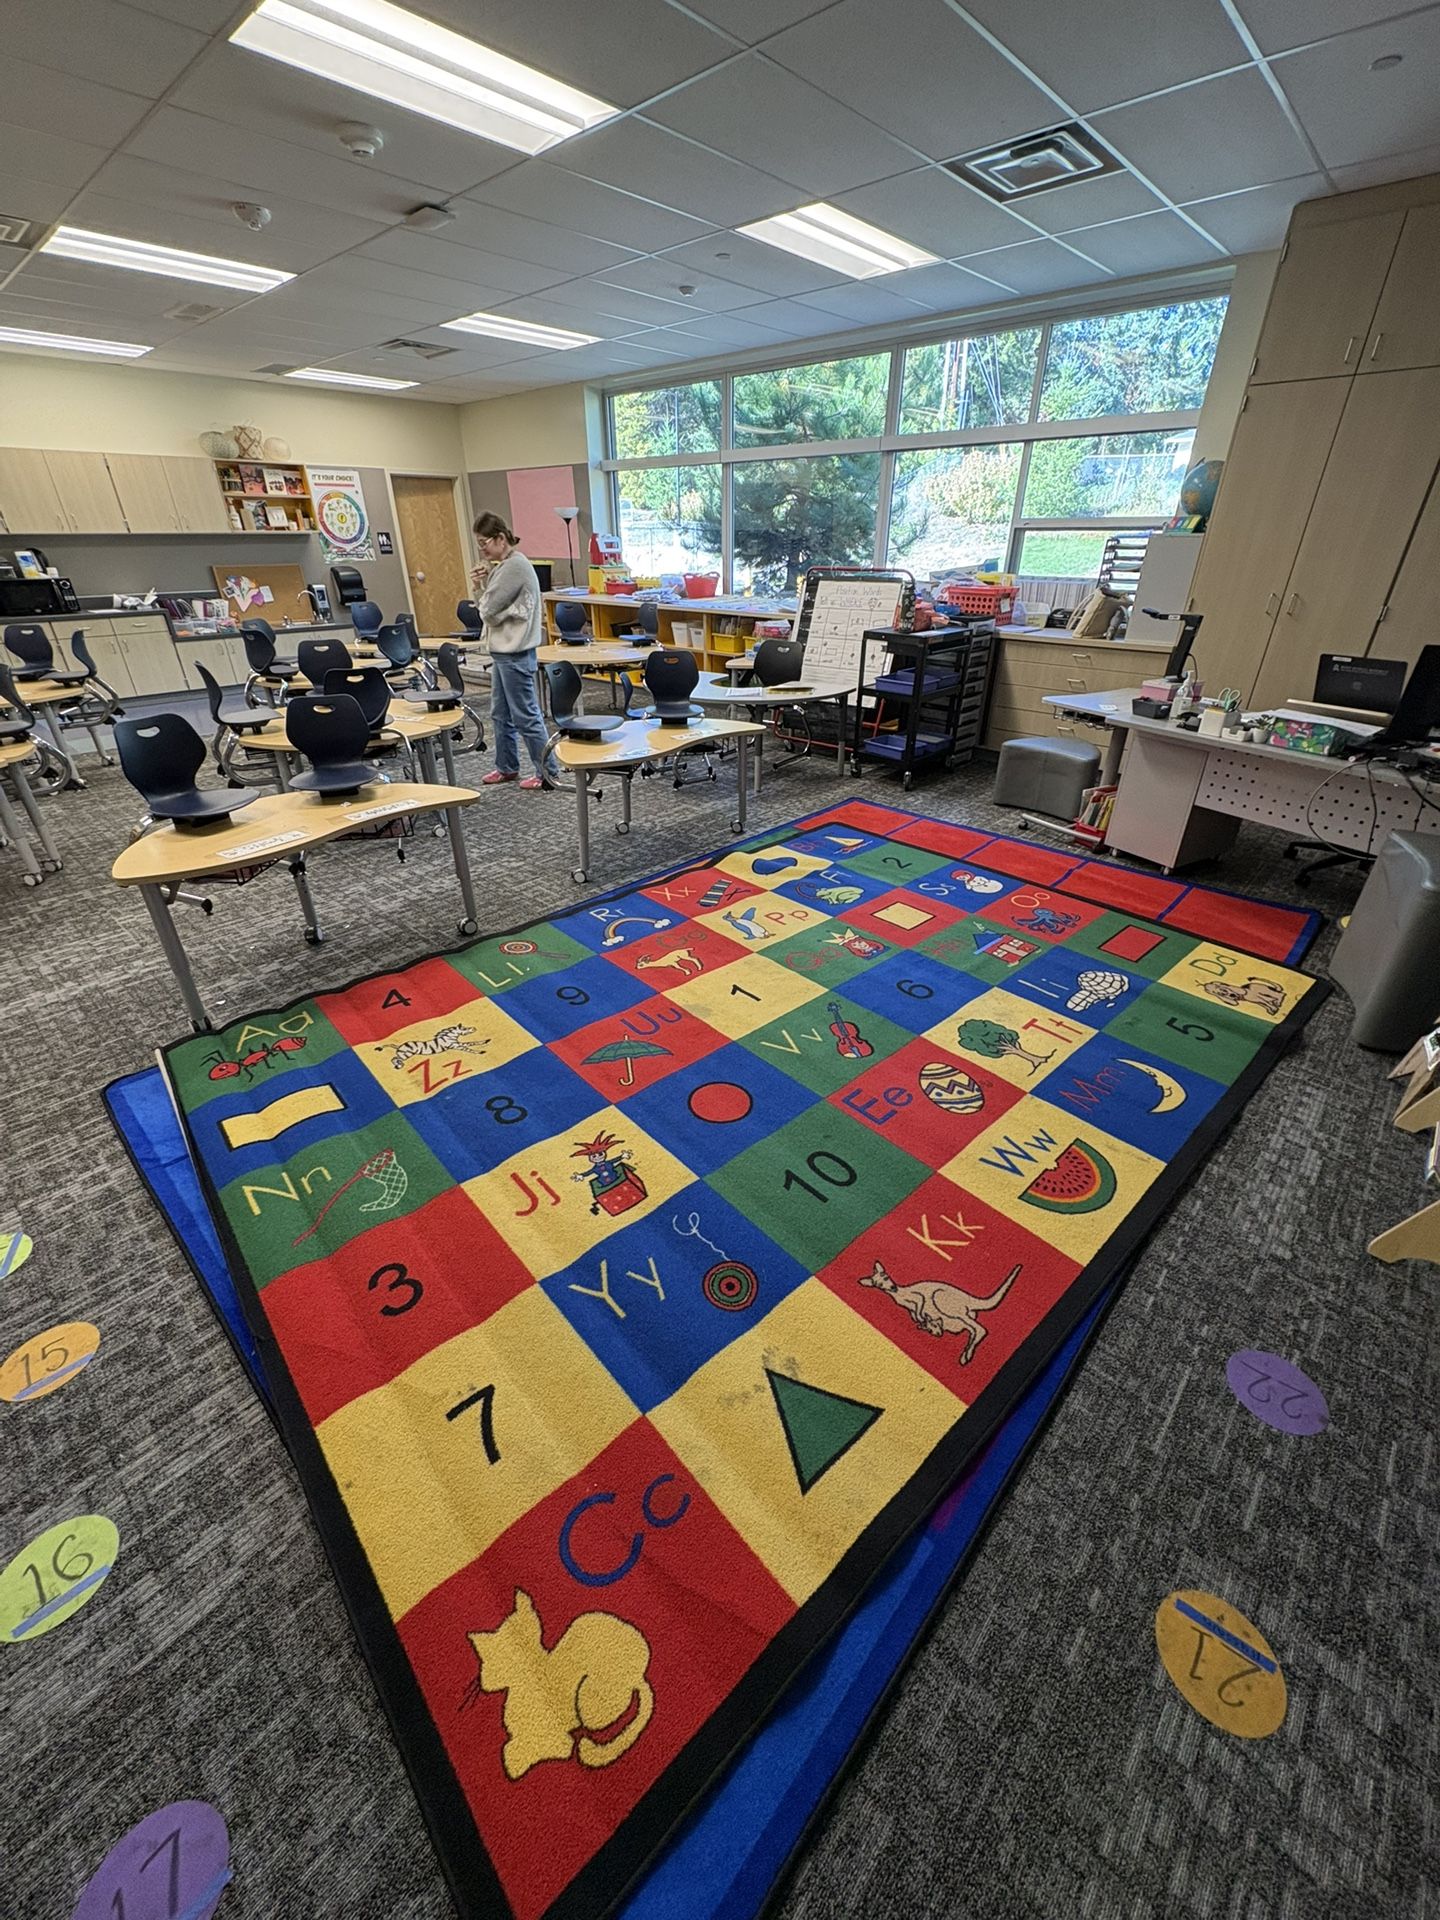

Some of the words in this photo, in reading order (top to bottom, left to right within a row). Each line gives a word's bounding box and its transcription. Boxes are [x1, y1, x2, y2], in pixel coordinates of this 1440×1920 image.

[881, 856, 912, 869] 2
[651, 886, 697, 901] Xx
[1011, 892, 1050, 908] Oo
[589, 906, 625, 922] Rr
[764, 909, 809, 925] Pp
[1189, 952, 1239, 977] Dd
[381, 988, 411, 1009] 4
[556, 986, 590, 1005] 9
[730, 984, 762, 1002] 1
[896, 979, 935, 999] 6
[1017, 978, 1070, 998] Ii
[236, 1010, 314, 1053] Aa
[620, 1008, 682, 1036] Uu
[1021, 1018, 1083, 1044] Tt
[1165, 1017, 1215, 1042] 5
[760, 1028, 823, 1055] Vv
[407, 1058, 473, 1094] Zz
[1059, 1064, 1128, 1115] Mm
[485, 1095, 528, 1124] 8
[841, 1087, 913, 1126] Ee
[979, 1128, 1058, 1177] Ww
[242, 1166, 332, 1216] Nn
[783, 1151, 858, 1203] 10
[510, 1170, 562, 1217] Jj
[906, 1211, 984, 1262] Kk
[368, 1262, 424, 1317] 3
[568, 1257, 666, 1319] Yy
[20, 1336, 69, 1387] 15
[1240, 1360, 1308, 1419] 22
[446, 1383, 501, 1466] 7
[558, 1473, 691, 1587] Cc
[22, 1534, 94, 1610] 16
